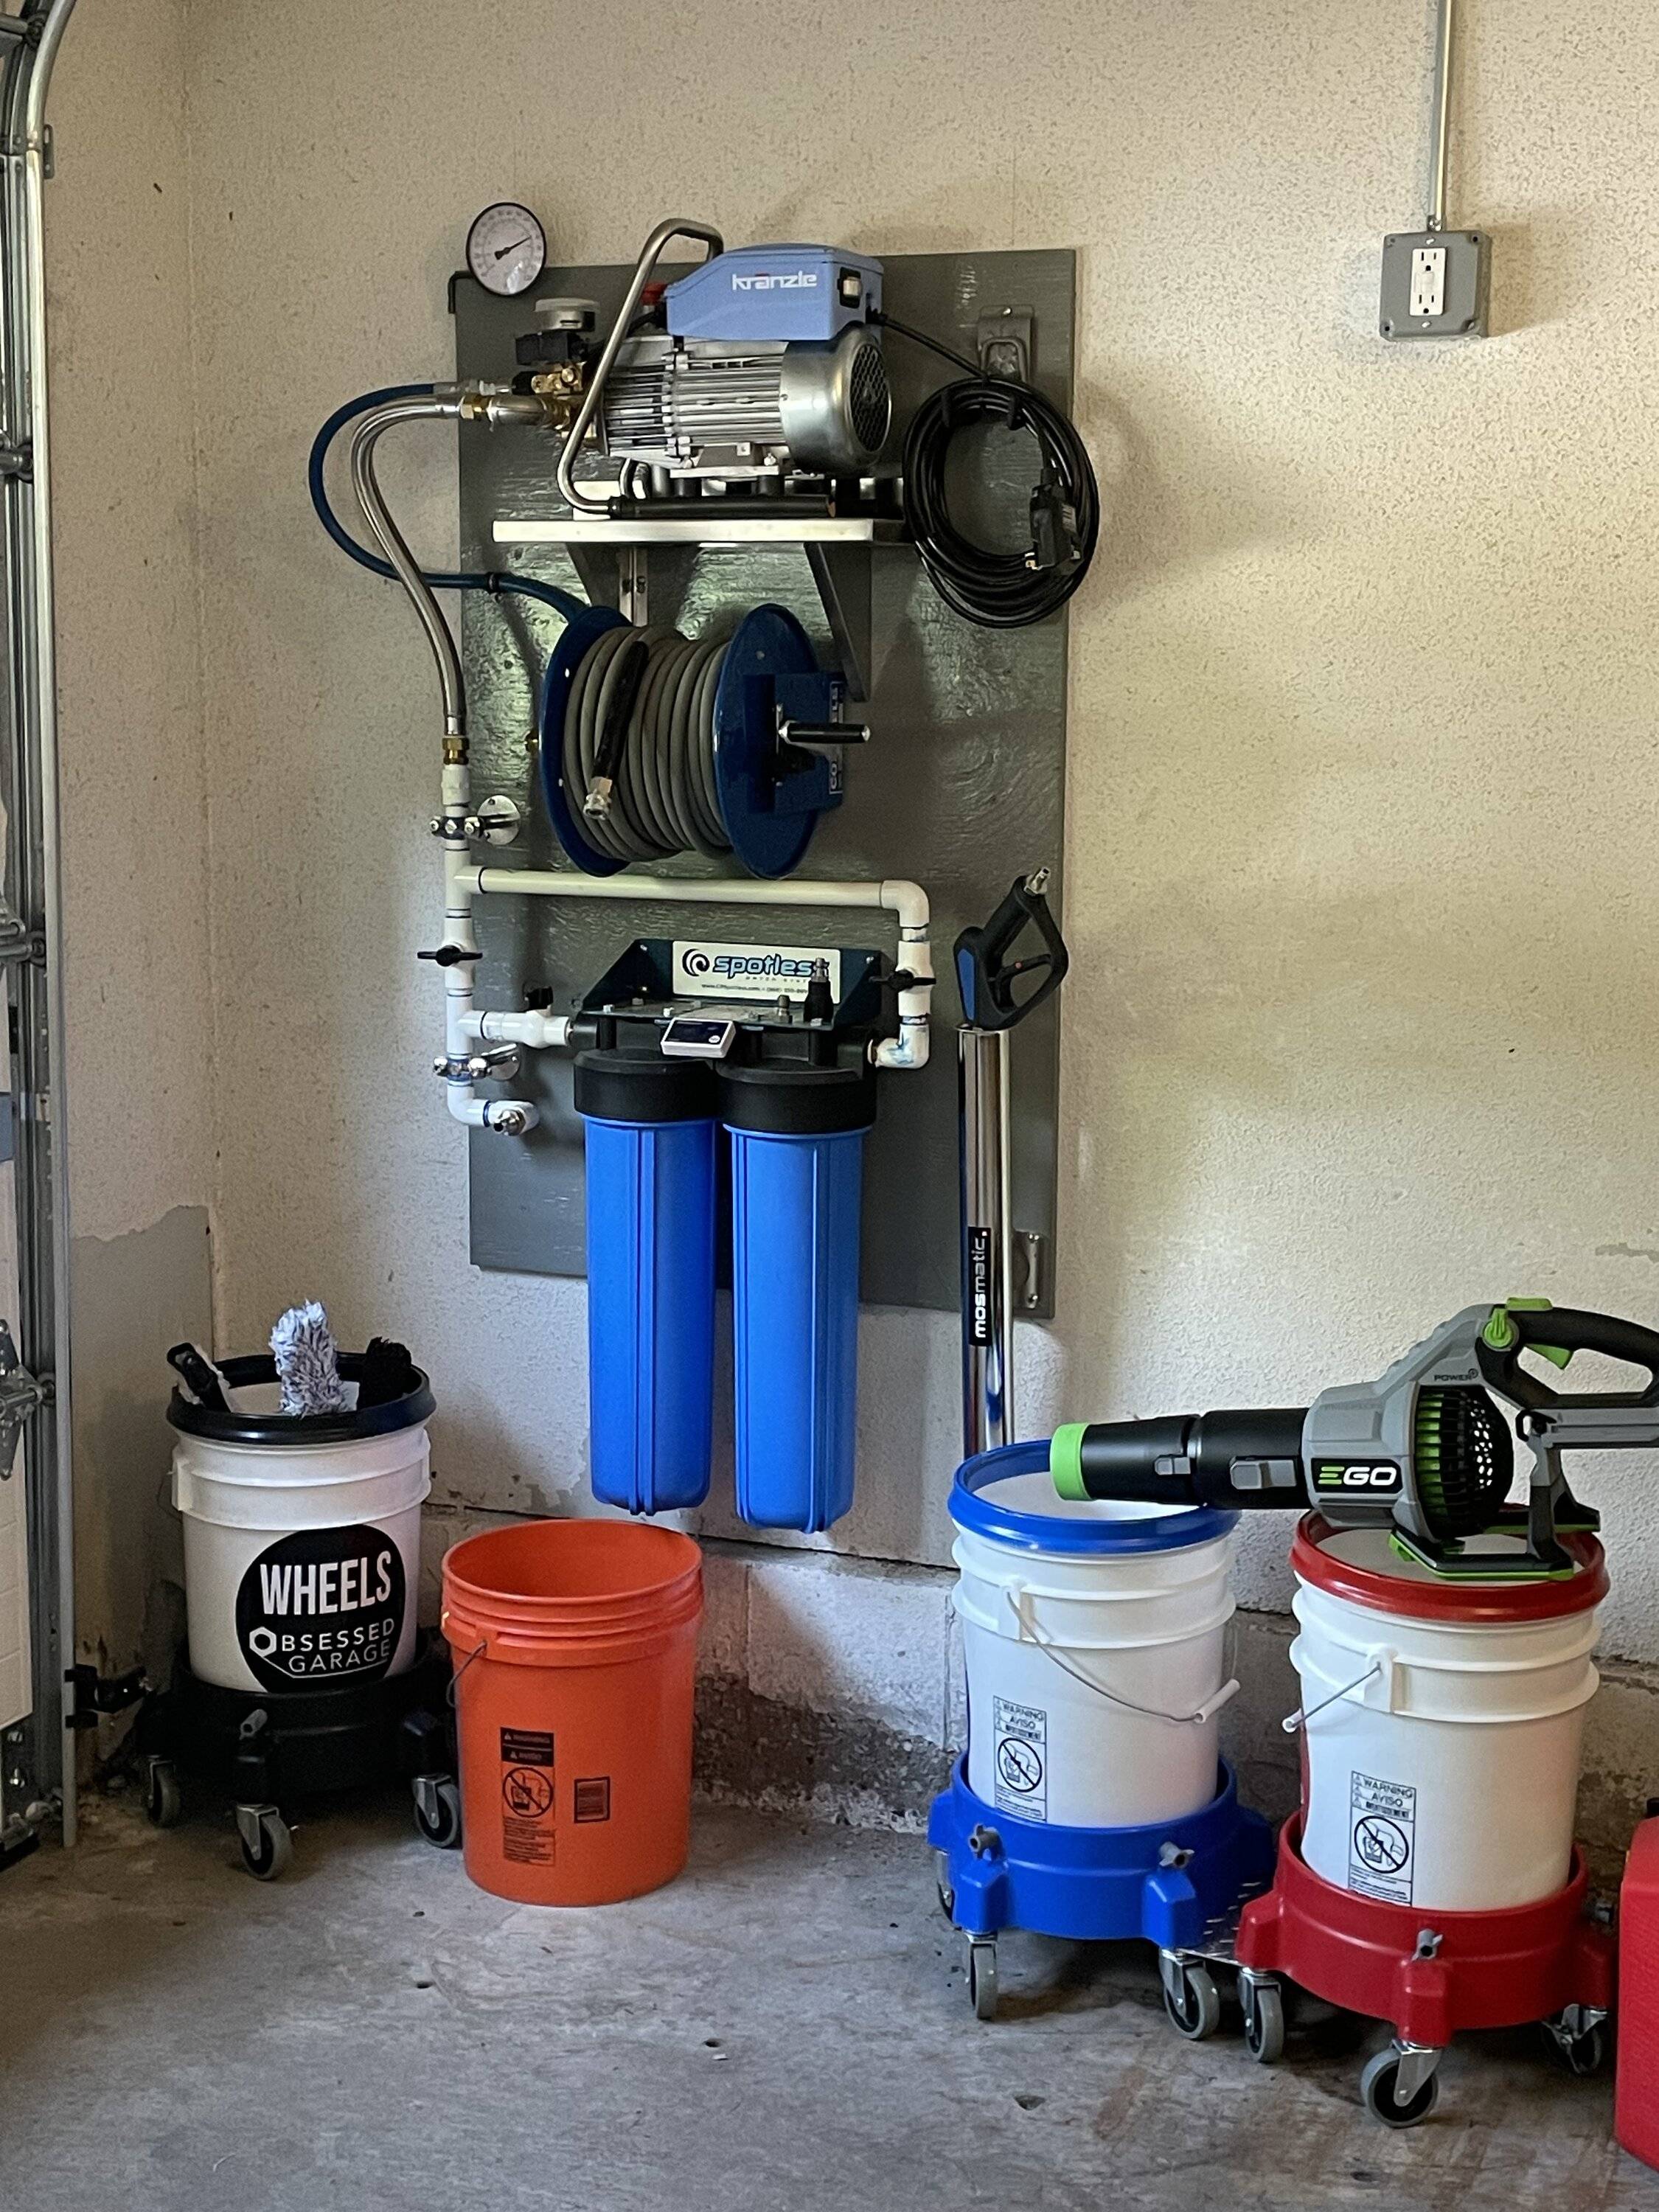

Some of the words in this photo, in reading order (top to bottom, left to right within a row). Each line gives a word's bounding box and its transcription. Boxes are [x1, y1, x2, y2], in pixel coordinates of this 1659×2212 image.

[712, 953, 830, 979] spotles
[1318, 1466, 1397, 1486] EGO
[260, 1551, 392, 1615] WHEELS
[288, 1638, 390, 1672] GARAGE
